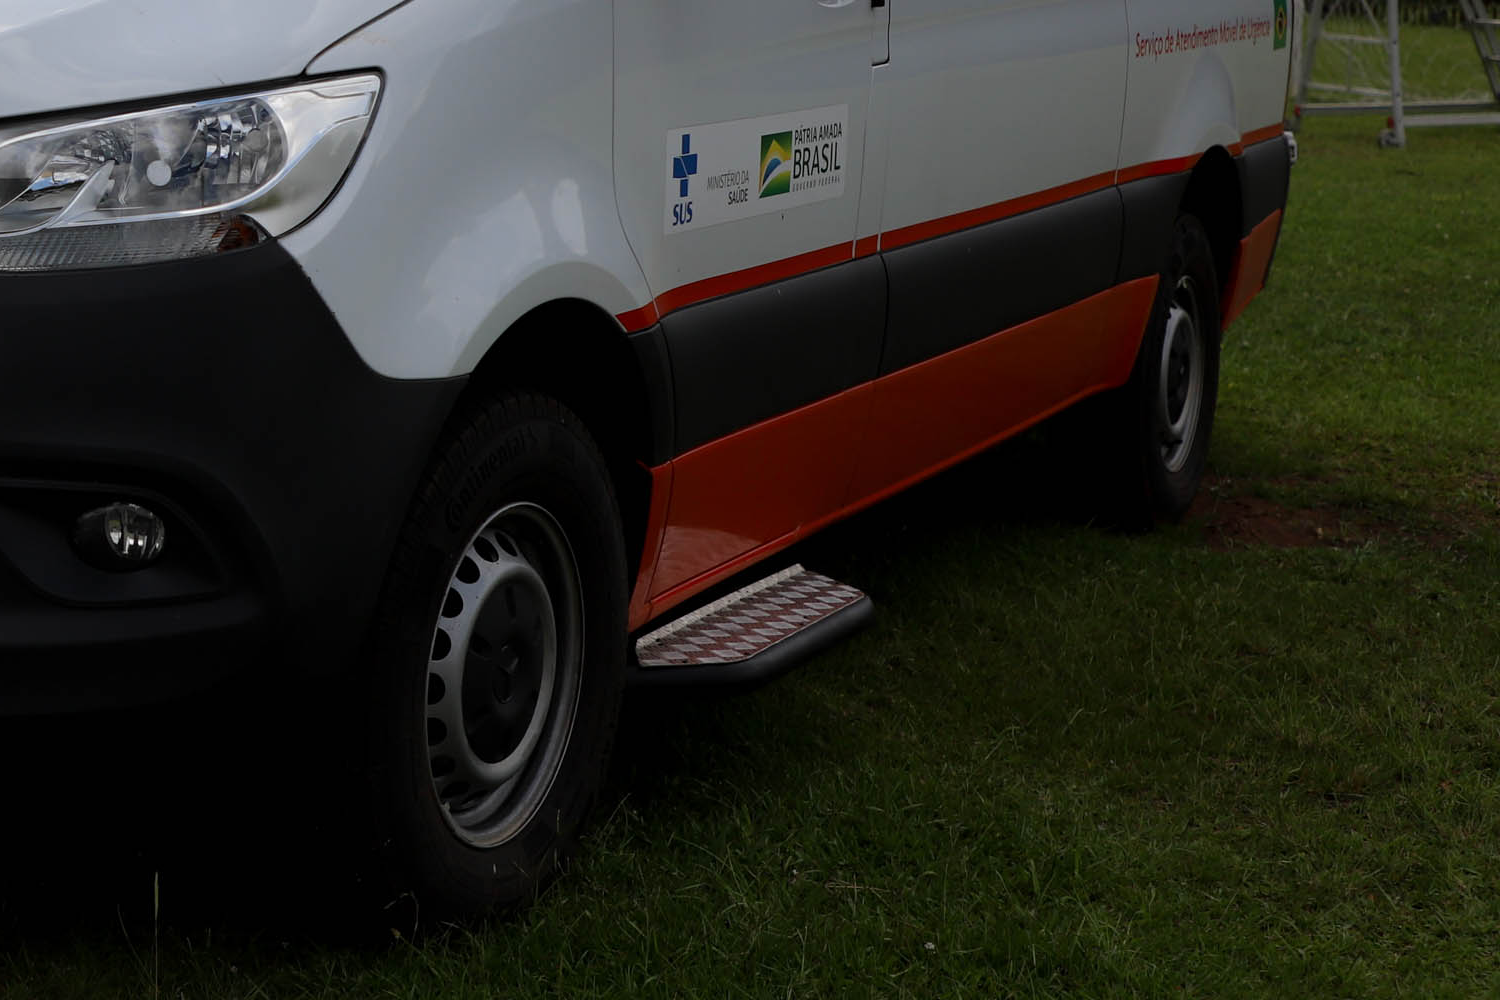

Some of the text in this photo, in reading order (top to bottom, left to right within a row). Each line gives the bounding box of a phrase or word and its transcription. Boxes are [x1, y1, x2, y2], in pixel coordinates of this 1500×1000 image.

[1135, 32, 1163, 63] Serviço
[1164, 26, 1174, 54] de
[794, 122, 842, 144] PÁTRIA AMADA
[793, 142, 841, 179] BRASIL
[728, 186, 748, 205] SAÚDE
[672, 201, 693, 227] SUS
